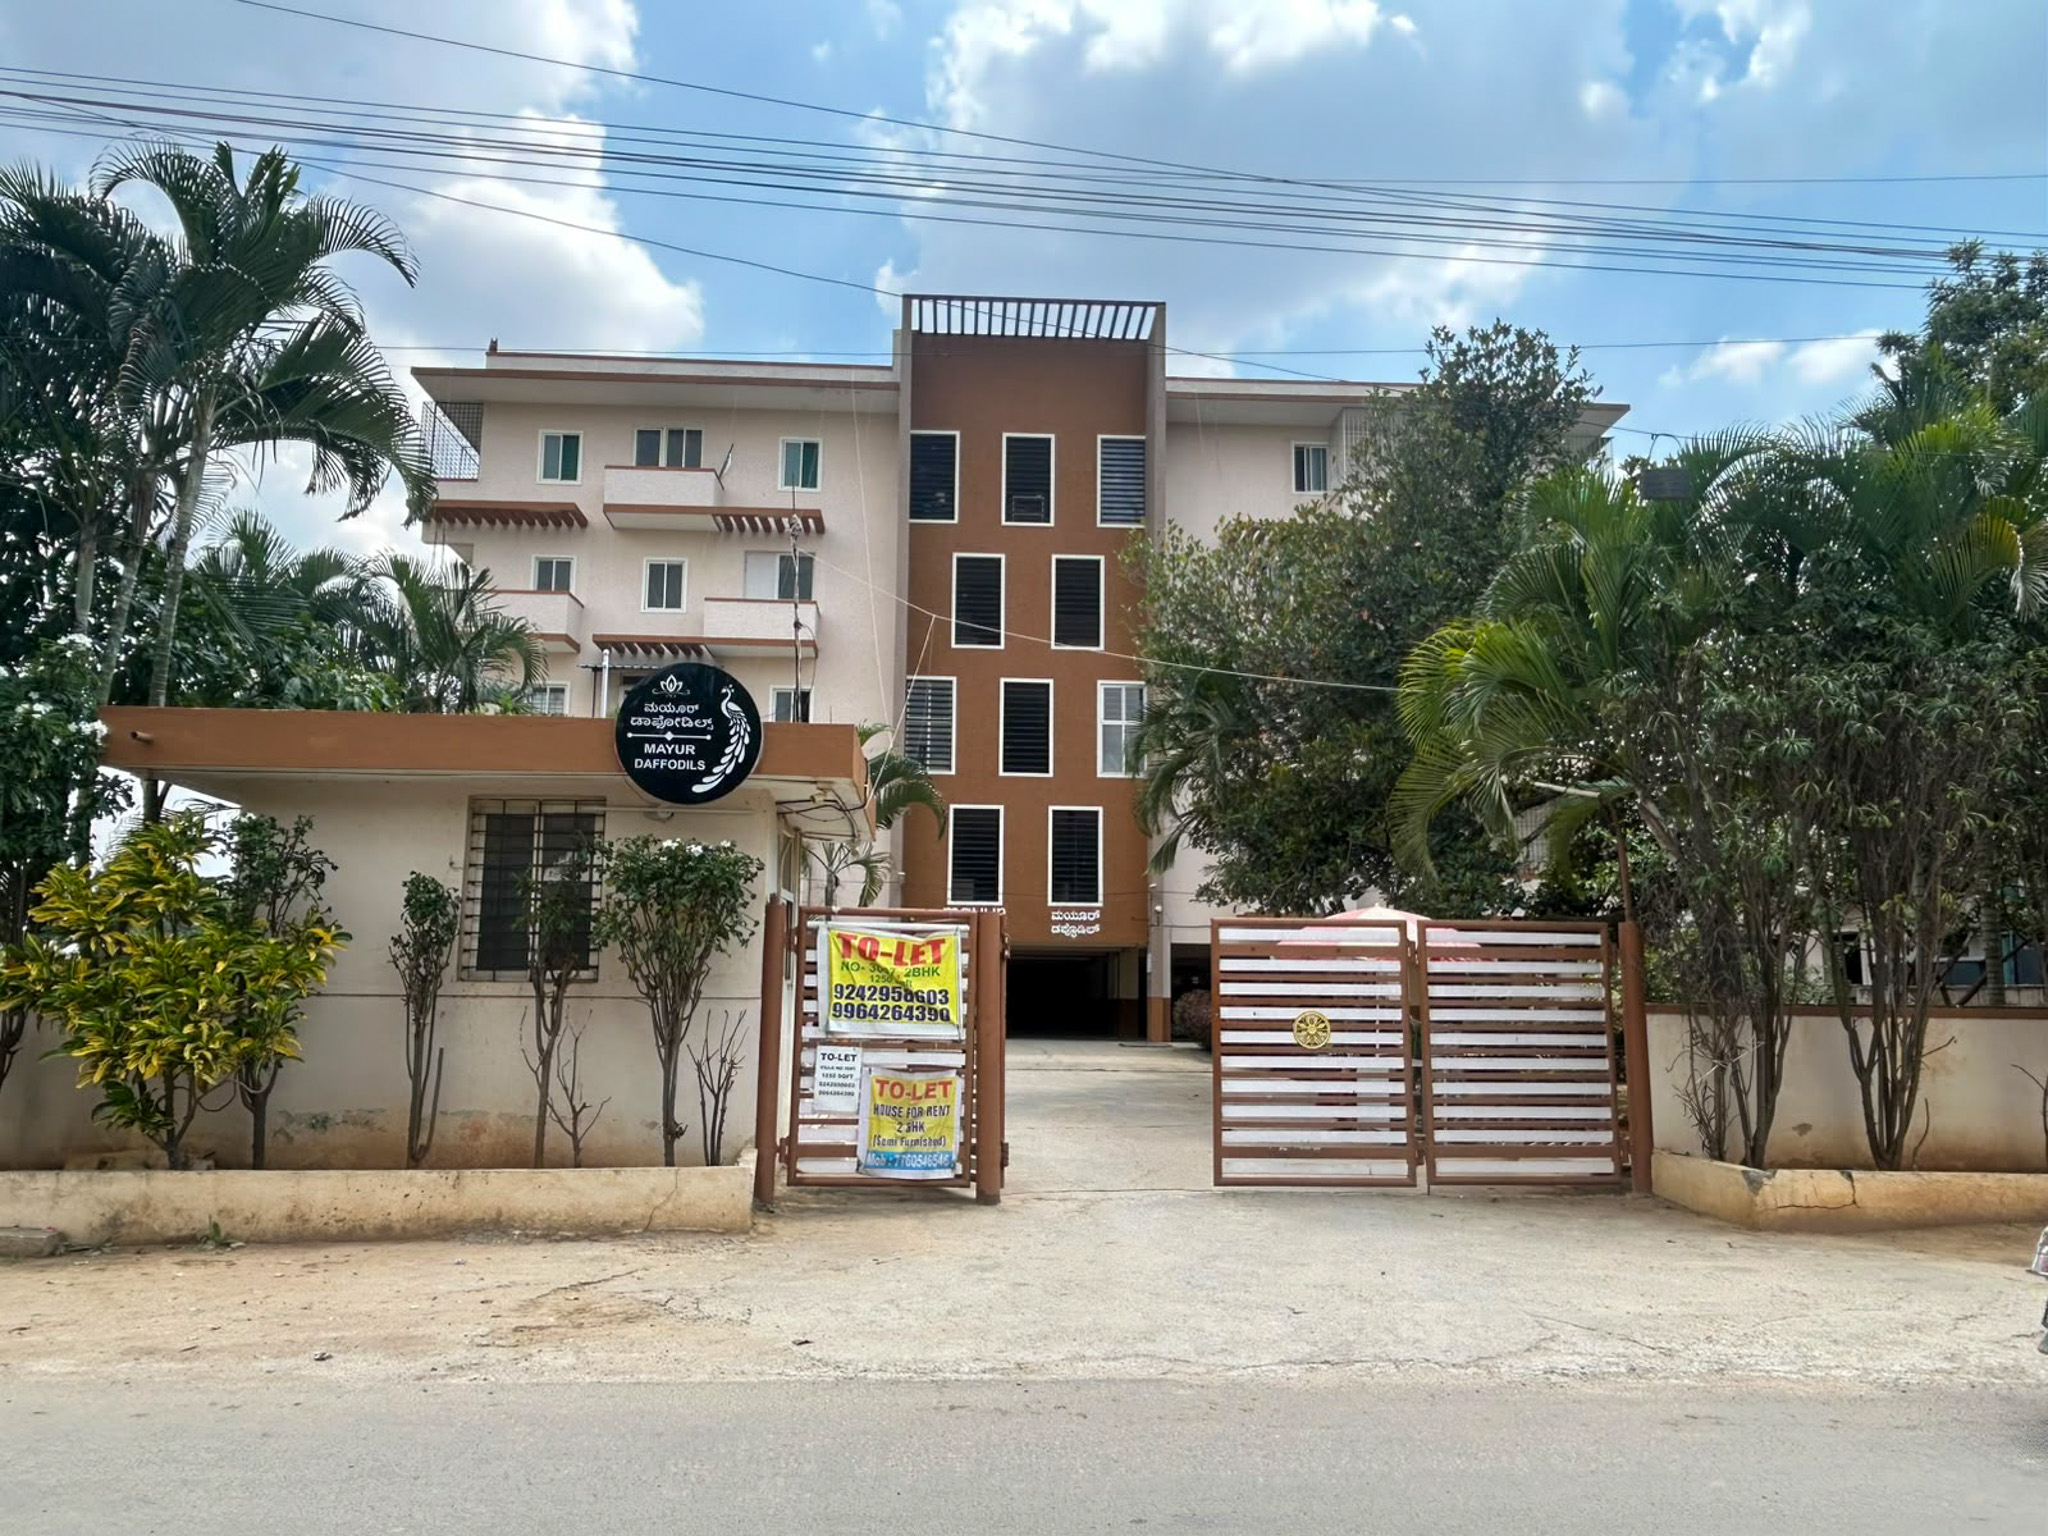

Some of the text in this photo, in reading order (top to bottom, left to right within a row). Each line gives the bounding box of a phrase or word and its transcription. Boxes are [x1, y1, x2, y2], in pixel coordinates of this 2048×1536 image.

[644, 702, 700, 714] ಮಯೂರ್
[644, 743, 696, 755] MAYUR
[634, 759, 706, 771] DAFFODILS
[837, 933, 946, 967] TO-LET
[904, 966, 941, 978] 2BHK
[833, 983, 950, 1005] 9242958603
[832, 1002, 951, 1022] 9964264390
[820, 1052, 857, 1062] TO-LET
[875, 1078, 953, 1101] TO-LET
[873, 1103, 951, 1119] HOUSE FOR RENT
[896, 1121, 903, 1133] 2
[872, 1134, 947, 1147] (Semi Furnished)
